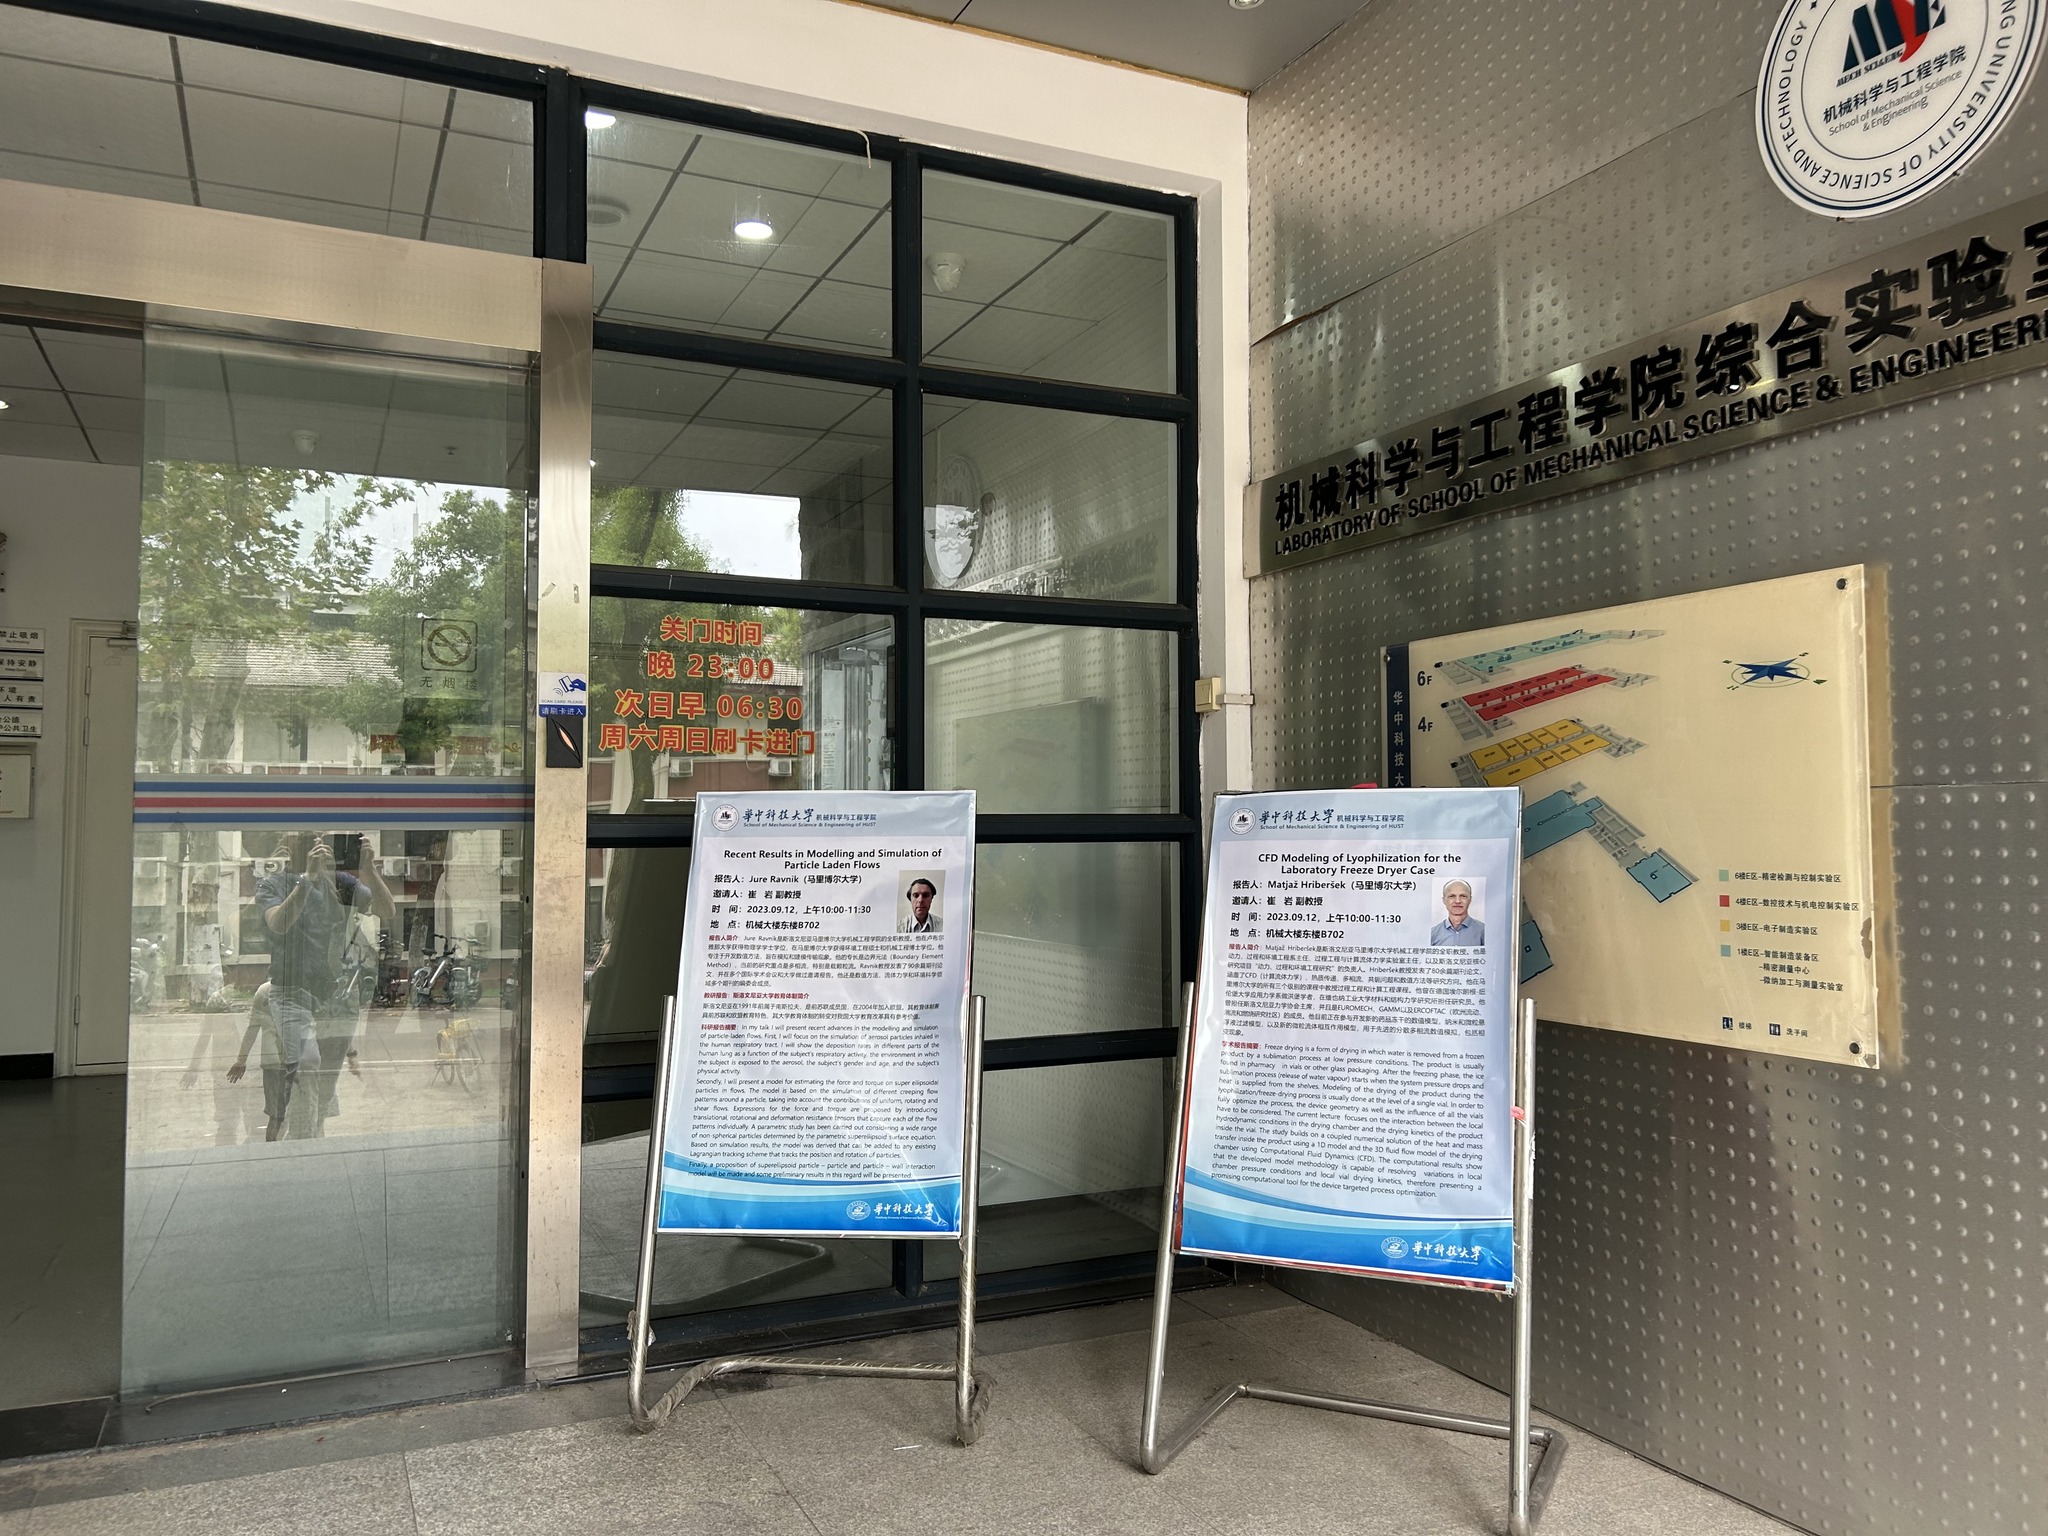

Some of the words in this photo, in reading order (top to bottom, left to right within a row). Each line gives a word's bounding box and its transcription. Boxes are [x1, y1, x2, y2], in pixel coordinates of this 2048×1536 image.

[1777, 20, 1808, 152] TECHNOLOGY
[1823, 45, 1967, 124] 机械科学与工程学院
[1828, 114, 1860, 137] School
[1860, 111, 1871, 124] of
[1871, 86, 1924, 117] Mechanical
[1925, 70, 1963, 94] Science
[1927, 35, 2012, 162] UNIVERSITY
[1862, 122, 1870, 132] &
[1870, 95, 1929, 128] Engineering
[1792, 148, 1820, 176] AND
[1898, 153, 1922, 179] OF
[1818, 166, 1892, 191] SCIENCE
[1275, 512, 1377, 556] LABORATORY
[1377, 506, 1402, 529] OF
[1407, 479, 1489, 520] SCHOOL
[1489, 467, 1523, 497] OF
[1523, 422, 1678, 485] MECHANICAL
[1683, 381, 1810, 439] SCIENCE
[1816, 374, 1842, 401] &
[659, 616, 762, 646] 关门时间
[648, 650, 675, 679] 晚
[686, 653, 774, 680] 23:00
[1417, 670, 1433, 687] 6F
[541, 706, 584, 716] 请刷卡进入
[614, 689, 706, 720] 次日早
[716, 694, 803, 720] 06:30
[1417, 716, 1433, 733] 4F
[600, 724, 816, 756] 周六周日刷卡进门
[816, 813, 877, 822] 机械科学与工程学院
[1336, 814, 1405, 823] 机械科学与工程学院
[723, 849, 757, 859] Recent
[759, 849, 793, 859] Results
[795, 849, 804, 858] in
[806, 848, 855, 860] Modelling
[857, 848, 875, 858] and
[877, 848, 929, 858] Simulation
[931, 848, 942, 858] of
[1258, 853, 1279, 863] CFD
[1281, 853, 1329, 865] Modeling
[1332, 852, 1344, 863] of
[1346, 853, 1421, 865] Lyophilization
[1423, 852, 1440, 863] for
[1443, 853, 1462, 863] the
[784, 860, 820, 870] Particle
[822, 860, 851, 869] Laden
[853, 860, 881, 869] Flows
[1281, 865, 1338, 877] Laboratory
[1340, 865, 1374, 875] Freeze
[1377, 865, 1408, 877] Dryer
[1410, 865, 1436, 875] Case
[748, 875, 768, 883] Jure
[770, 875, 799, 883] Ravnik
[1267, 880, 1298, 891] Matjaž
[1300, 880, 1346, 889] Hriberšek
[763, 890, 773, 899] 岩
[775, 890, 802, 900] 副教授
[1283, 896, 1293, 906] 岩
[1295, 896, 1323, 906] 副教授
[696, 1068, 720, 1076] physical
[733, 1105, 766, 1113] Expressions
[794, 1104, 809, 1112] force
[812, 1105, 824, 1113] and
[894, 1107, 904, 1115] by
[1211, 1173, 1241, 1182] promising
[1241, 1175, 1286, 1185] computational
[1286, 1178, 1299, 1186] tool
[1299, 1179, 1309, 1187] for
[1309, 1180, 1321, 1188] the
[1321, 1181, 1342, 1190] device
[1342, 1183, 1370, 1193] targeted
[1370, 1187, 1395, 1195] process
[1395, 1189, 1437, 1198] optimization.
